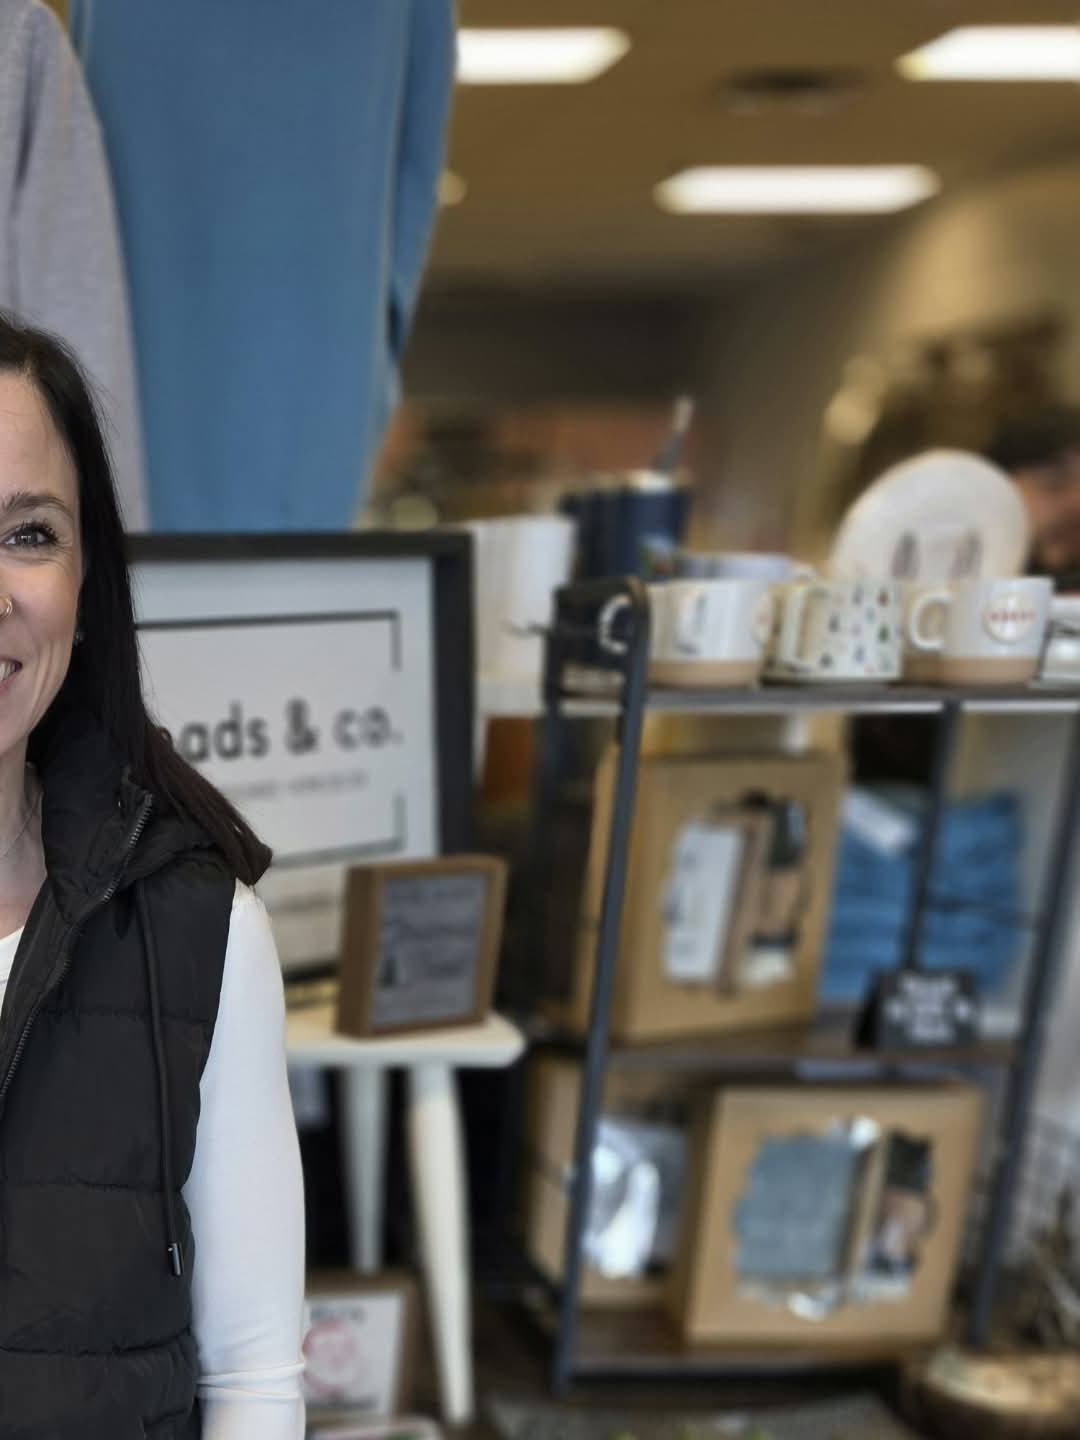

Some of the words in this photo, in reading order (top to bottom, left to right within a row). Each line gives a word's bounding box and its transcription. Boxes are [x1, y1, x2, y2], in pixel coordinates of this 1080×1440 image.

[177, 699, 271, 763] ads
[284, 696, 320, 756] &
[332, 706, 404, 750] co.
